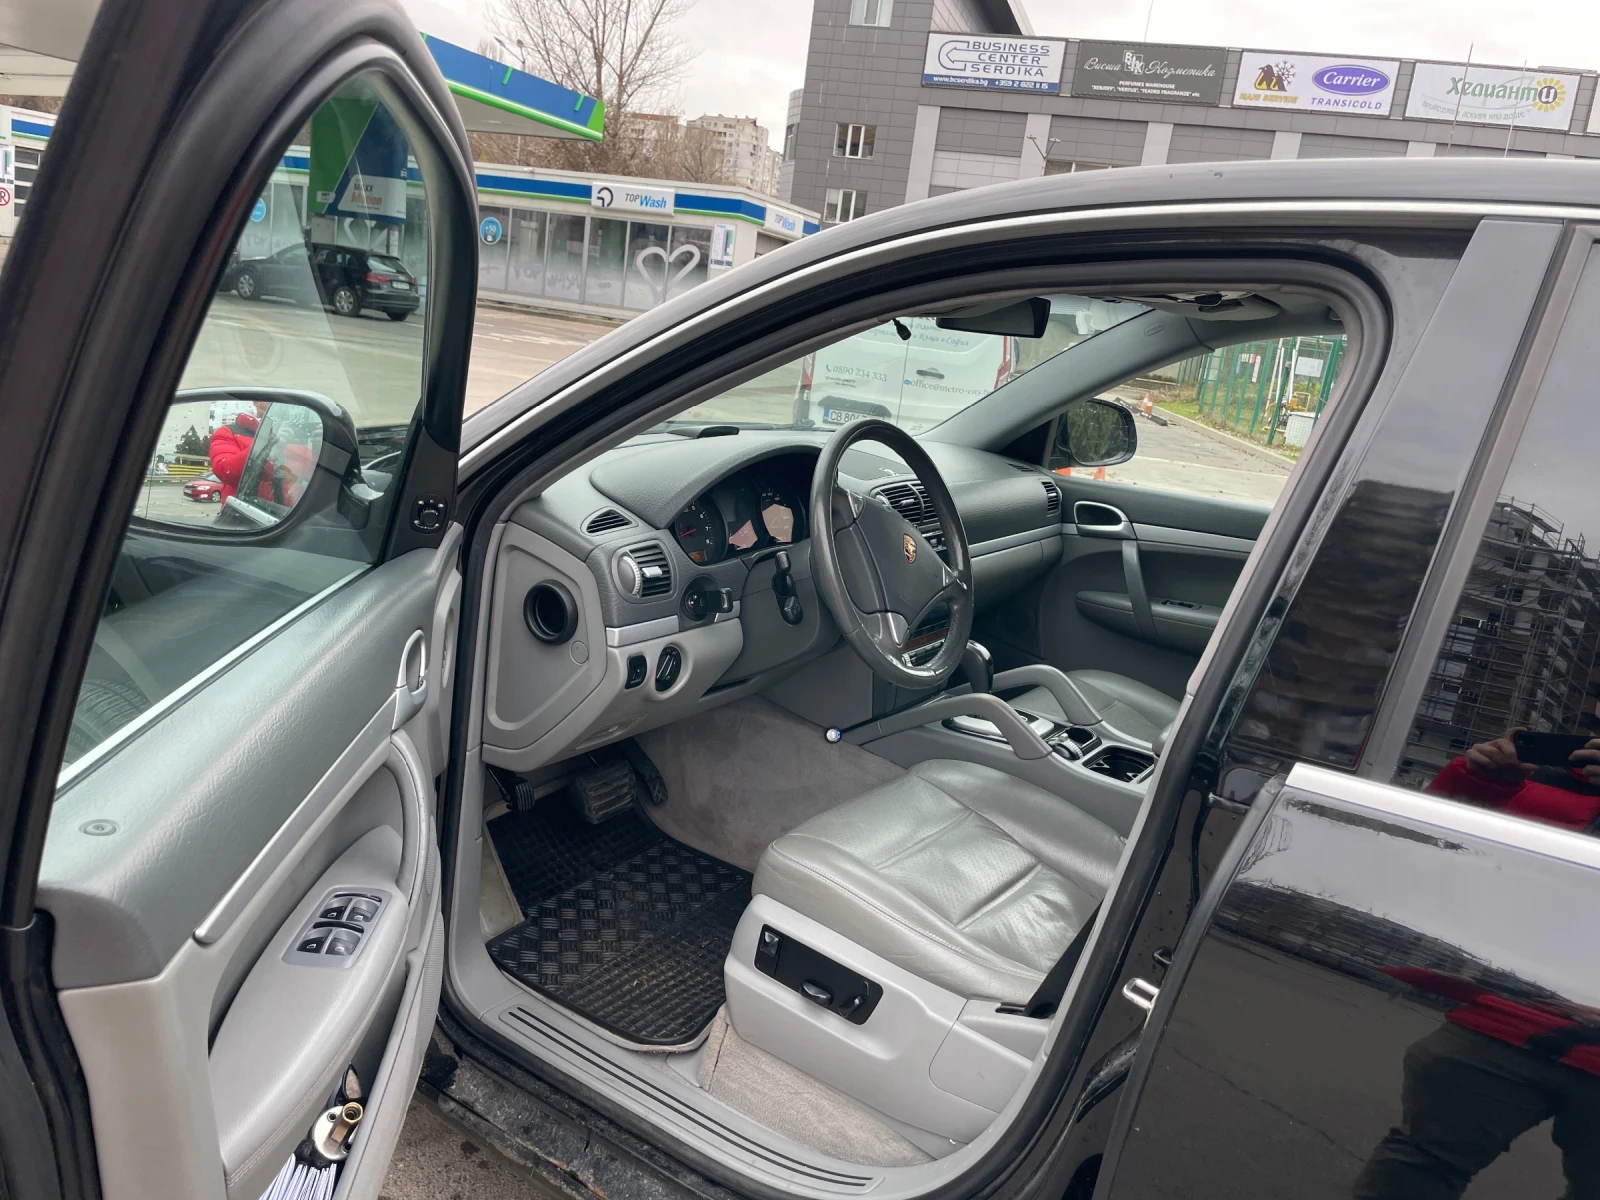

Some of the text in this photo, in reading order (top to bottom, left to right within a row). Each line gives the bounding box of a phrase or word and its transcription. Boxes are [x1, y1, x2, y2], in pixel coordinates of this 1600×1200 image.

[972, 41, 1049, 54] BUSINESS
[978, 52, 1041, 65] CENTER
[970, 63, 1044, 77] SERDIKA
[1083, 57, 1216, 79] Висша Козметика
[933, 76, 988, 86] www.bcserdika.bg
[995, 80, 1012, 88] +359
[1118, 80, 1176, 90] PERFUMES WAREHOUSE
[1323, 71, 1381, 87] Carrier
[1311, 97, 1383, 110] TRANSICOLD
[625, 193, 668, 209] TOP Wash
[775, 213, 797, 232] TOP Wash
[833, 366, 888, 382] 0890 234 333
[911, 379, 990, 395] office@metro-city.b
